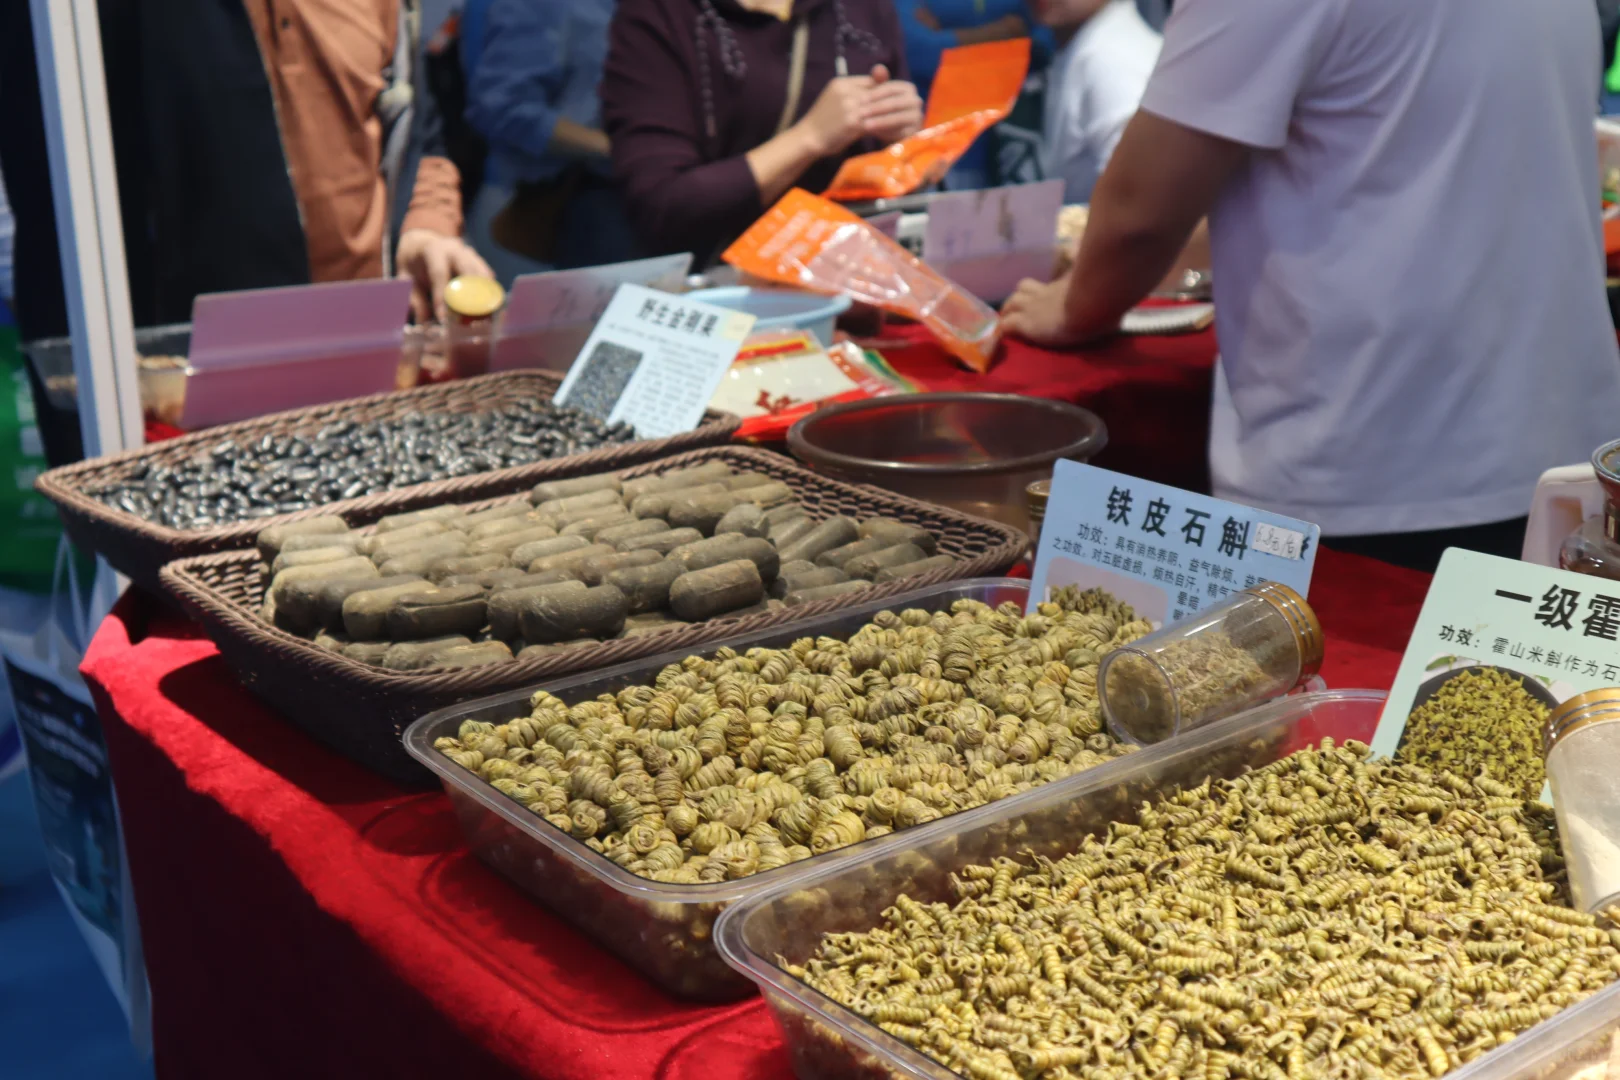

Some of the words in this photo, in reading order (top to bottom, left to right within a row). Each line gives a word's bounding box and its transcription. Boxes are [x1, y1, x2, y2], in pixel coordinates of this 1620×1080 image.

[1106, 485, 1250, 560] 铁皮石斛
[1495, 583, 1620, 641] 一级霍
